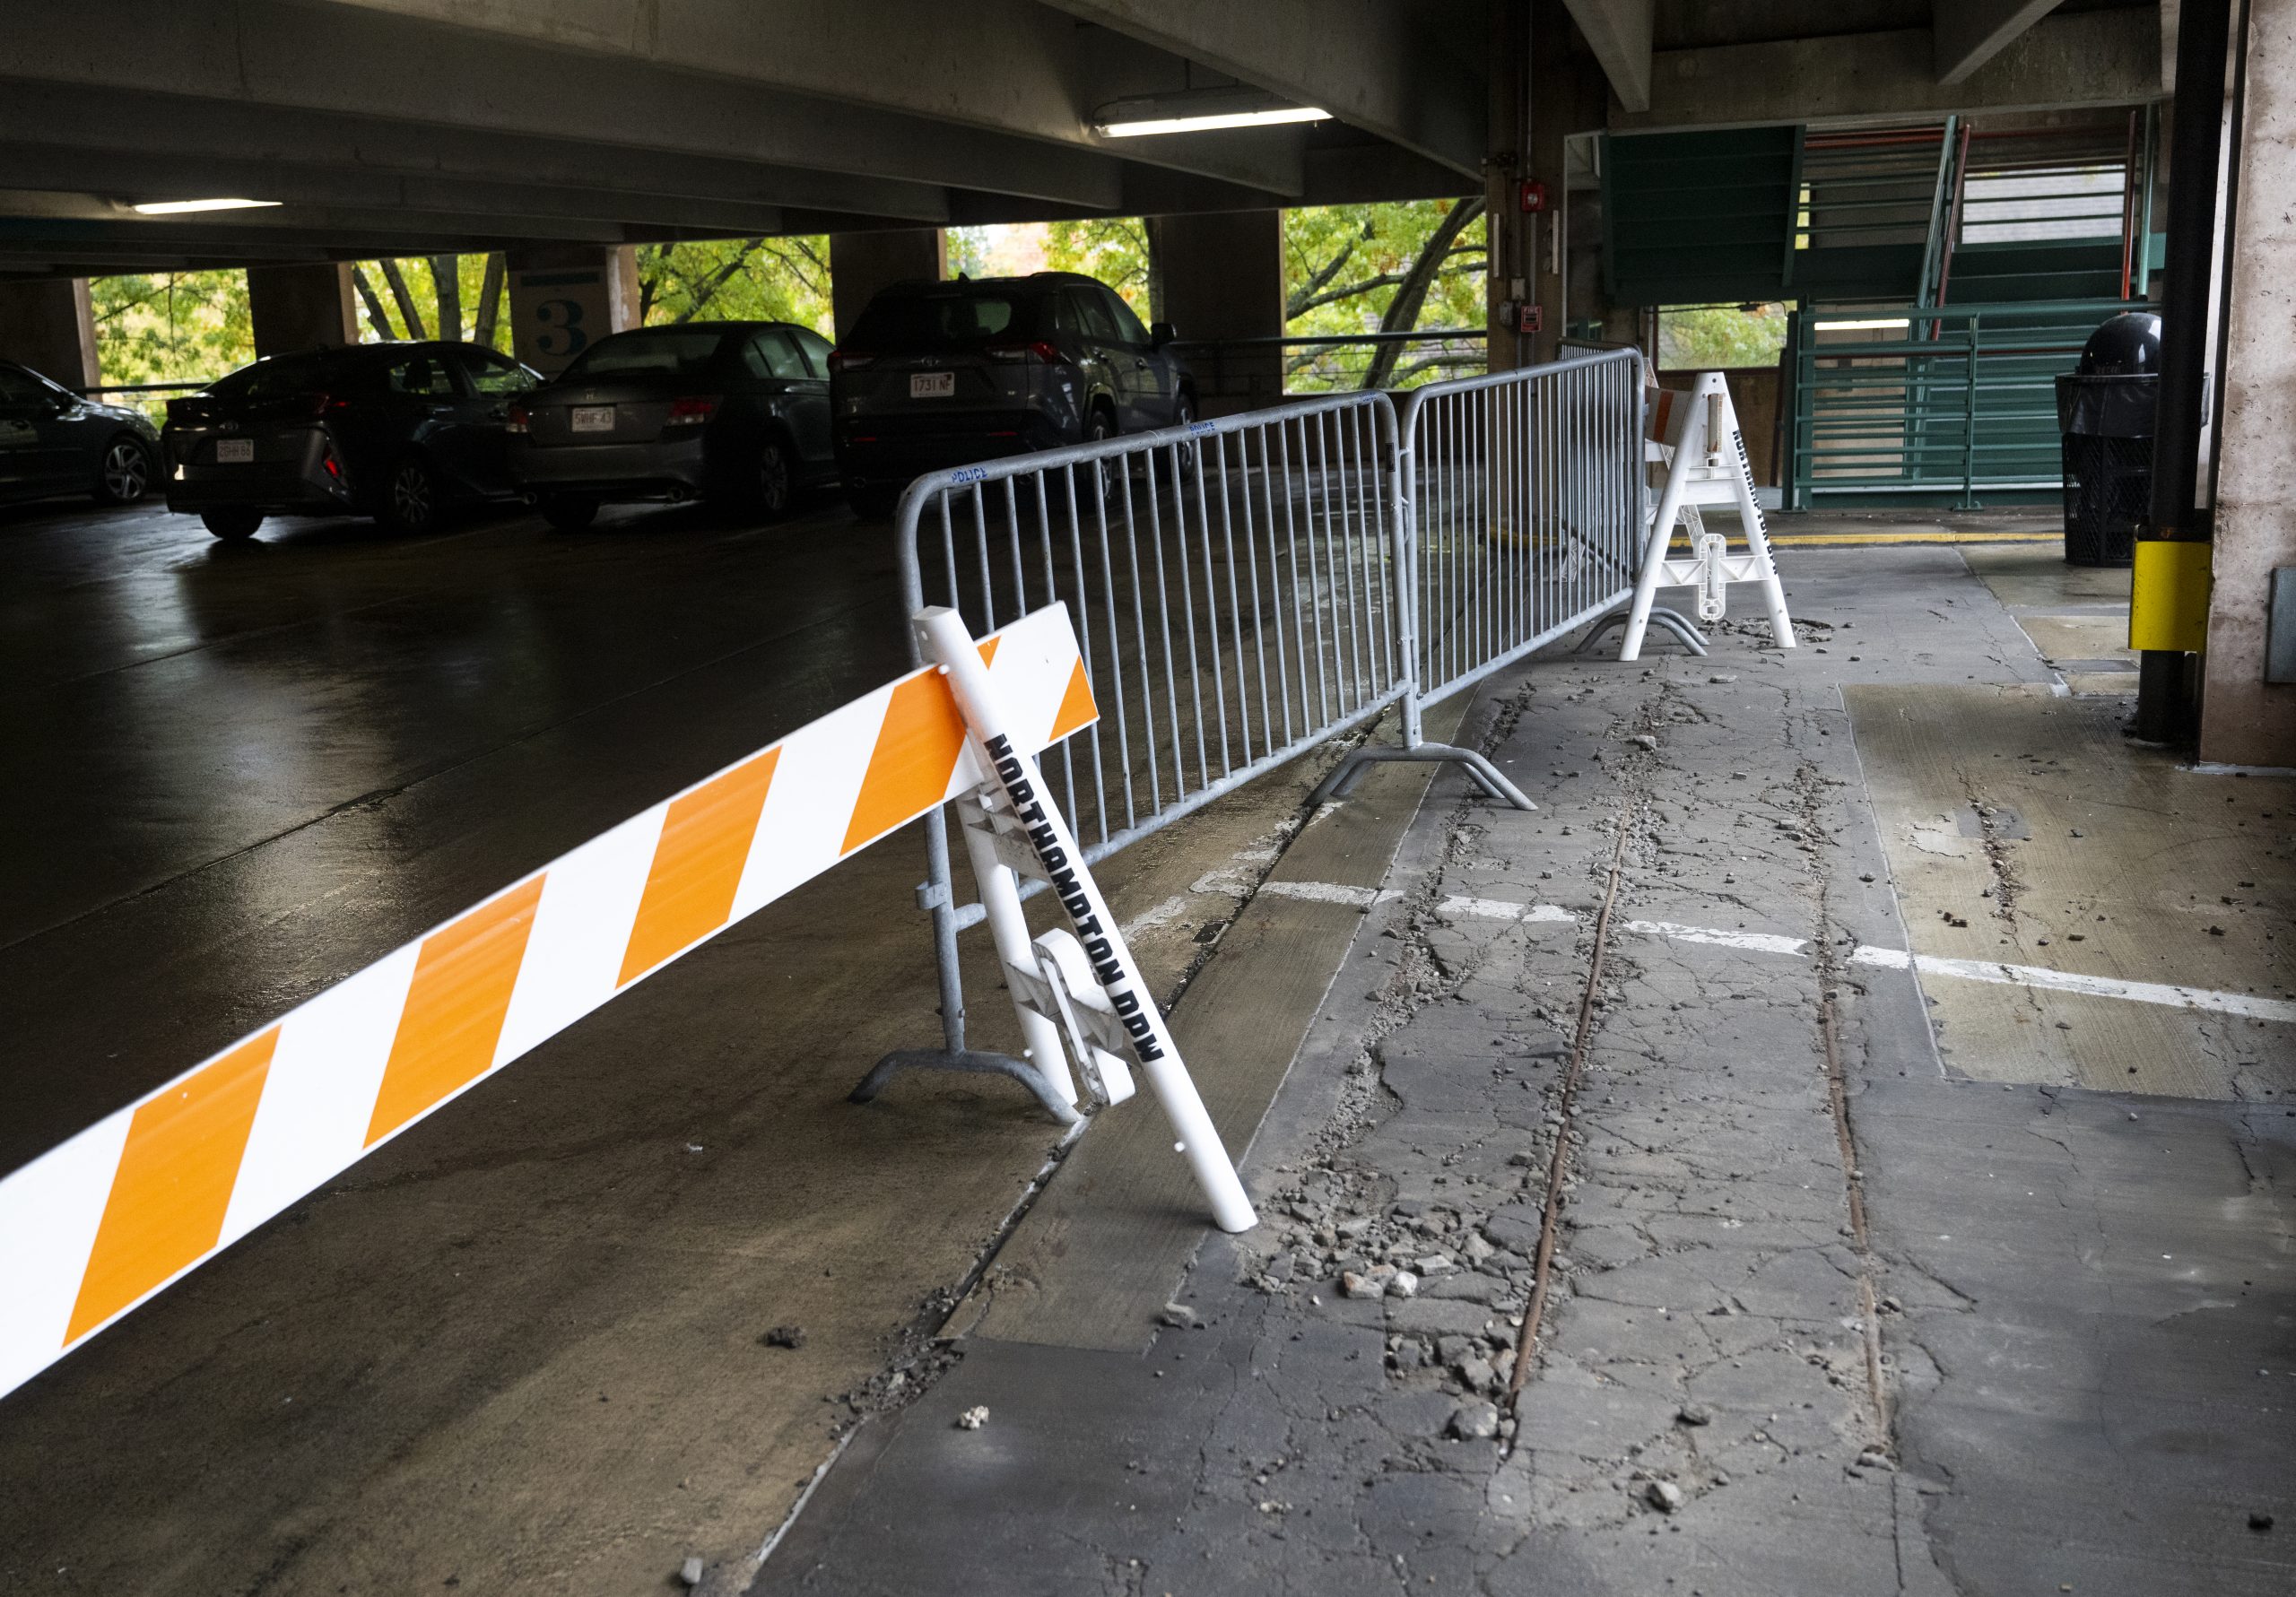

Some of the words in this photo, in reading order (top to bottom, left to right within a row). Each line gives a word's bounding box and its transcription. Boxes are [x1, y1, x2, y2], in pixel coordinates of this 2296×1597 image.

[535, 299, 587, 356] 3
[914, 379, 935, 392] 1731
[952, 467, 987, 482] POLICE
[984, 733, 1126, 986] NORTHAMPTON
[1112, 989, 1165, 1063] DPW
